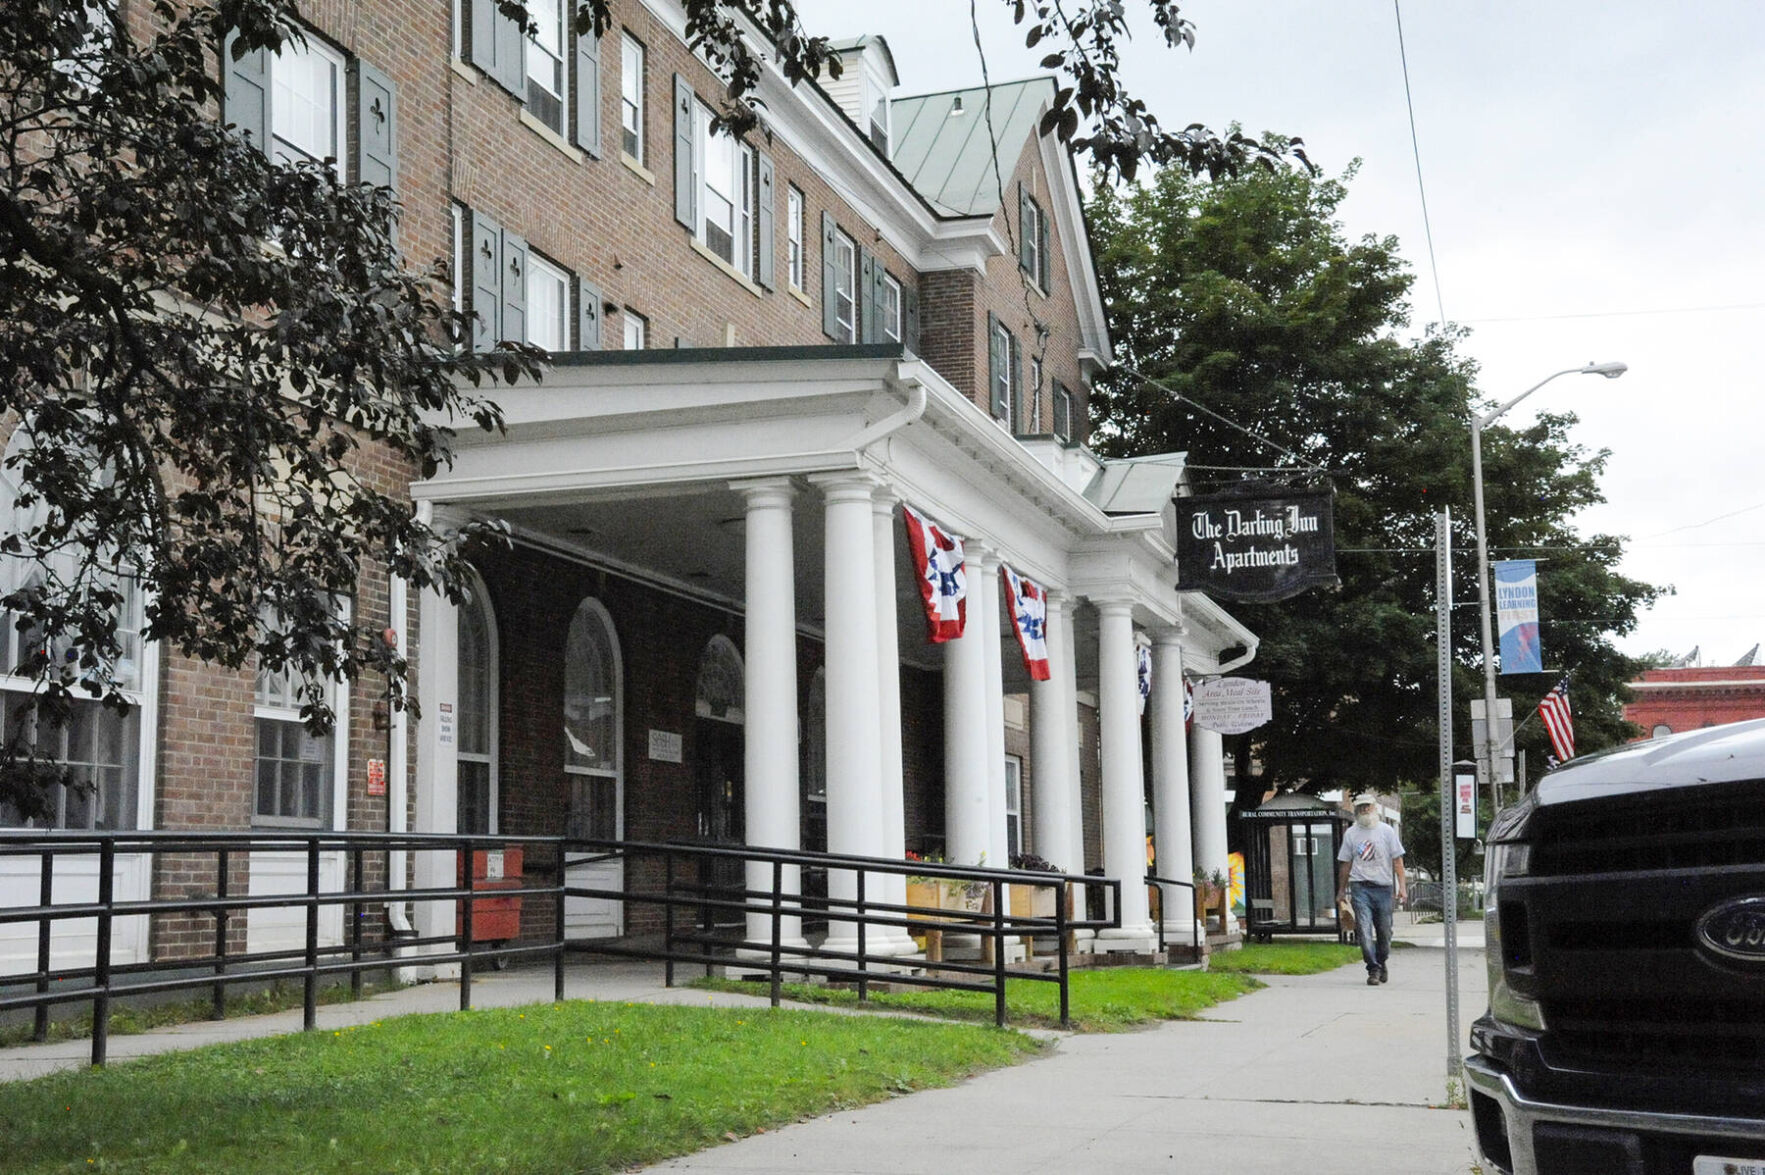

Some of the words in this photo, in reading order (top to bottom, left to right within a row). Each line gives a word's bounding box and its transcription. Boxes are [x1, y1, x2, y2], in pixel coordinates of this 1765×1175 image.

[1192, 510, 1222, 539] The
[1224, 508, 1284, 542] Darling
[1285, 505, 1318, 537] Inn
[1210, 541, 1299, 574] Apartments
[1498, 586, 1535, 599] LYNDON
[1498, 599, 1536, 610] LEARNING
